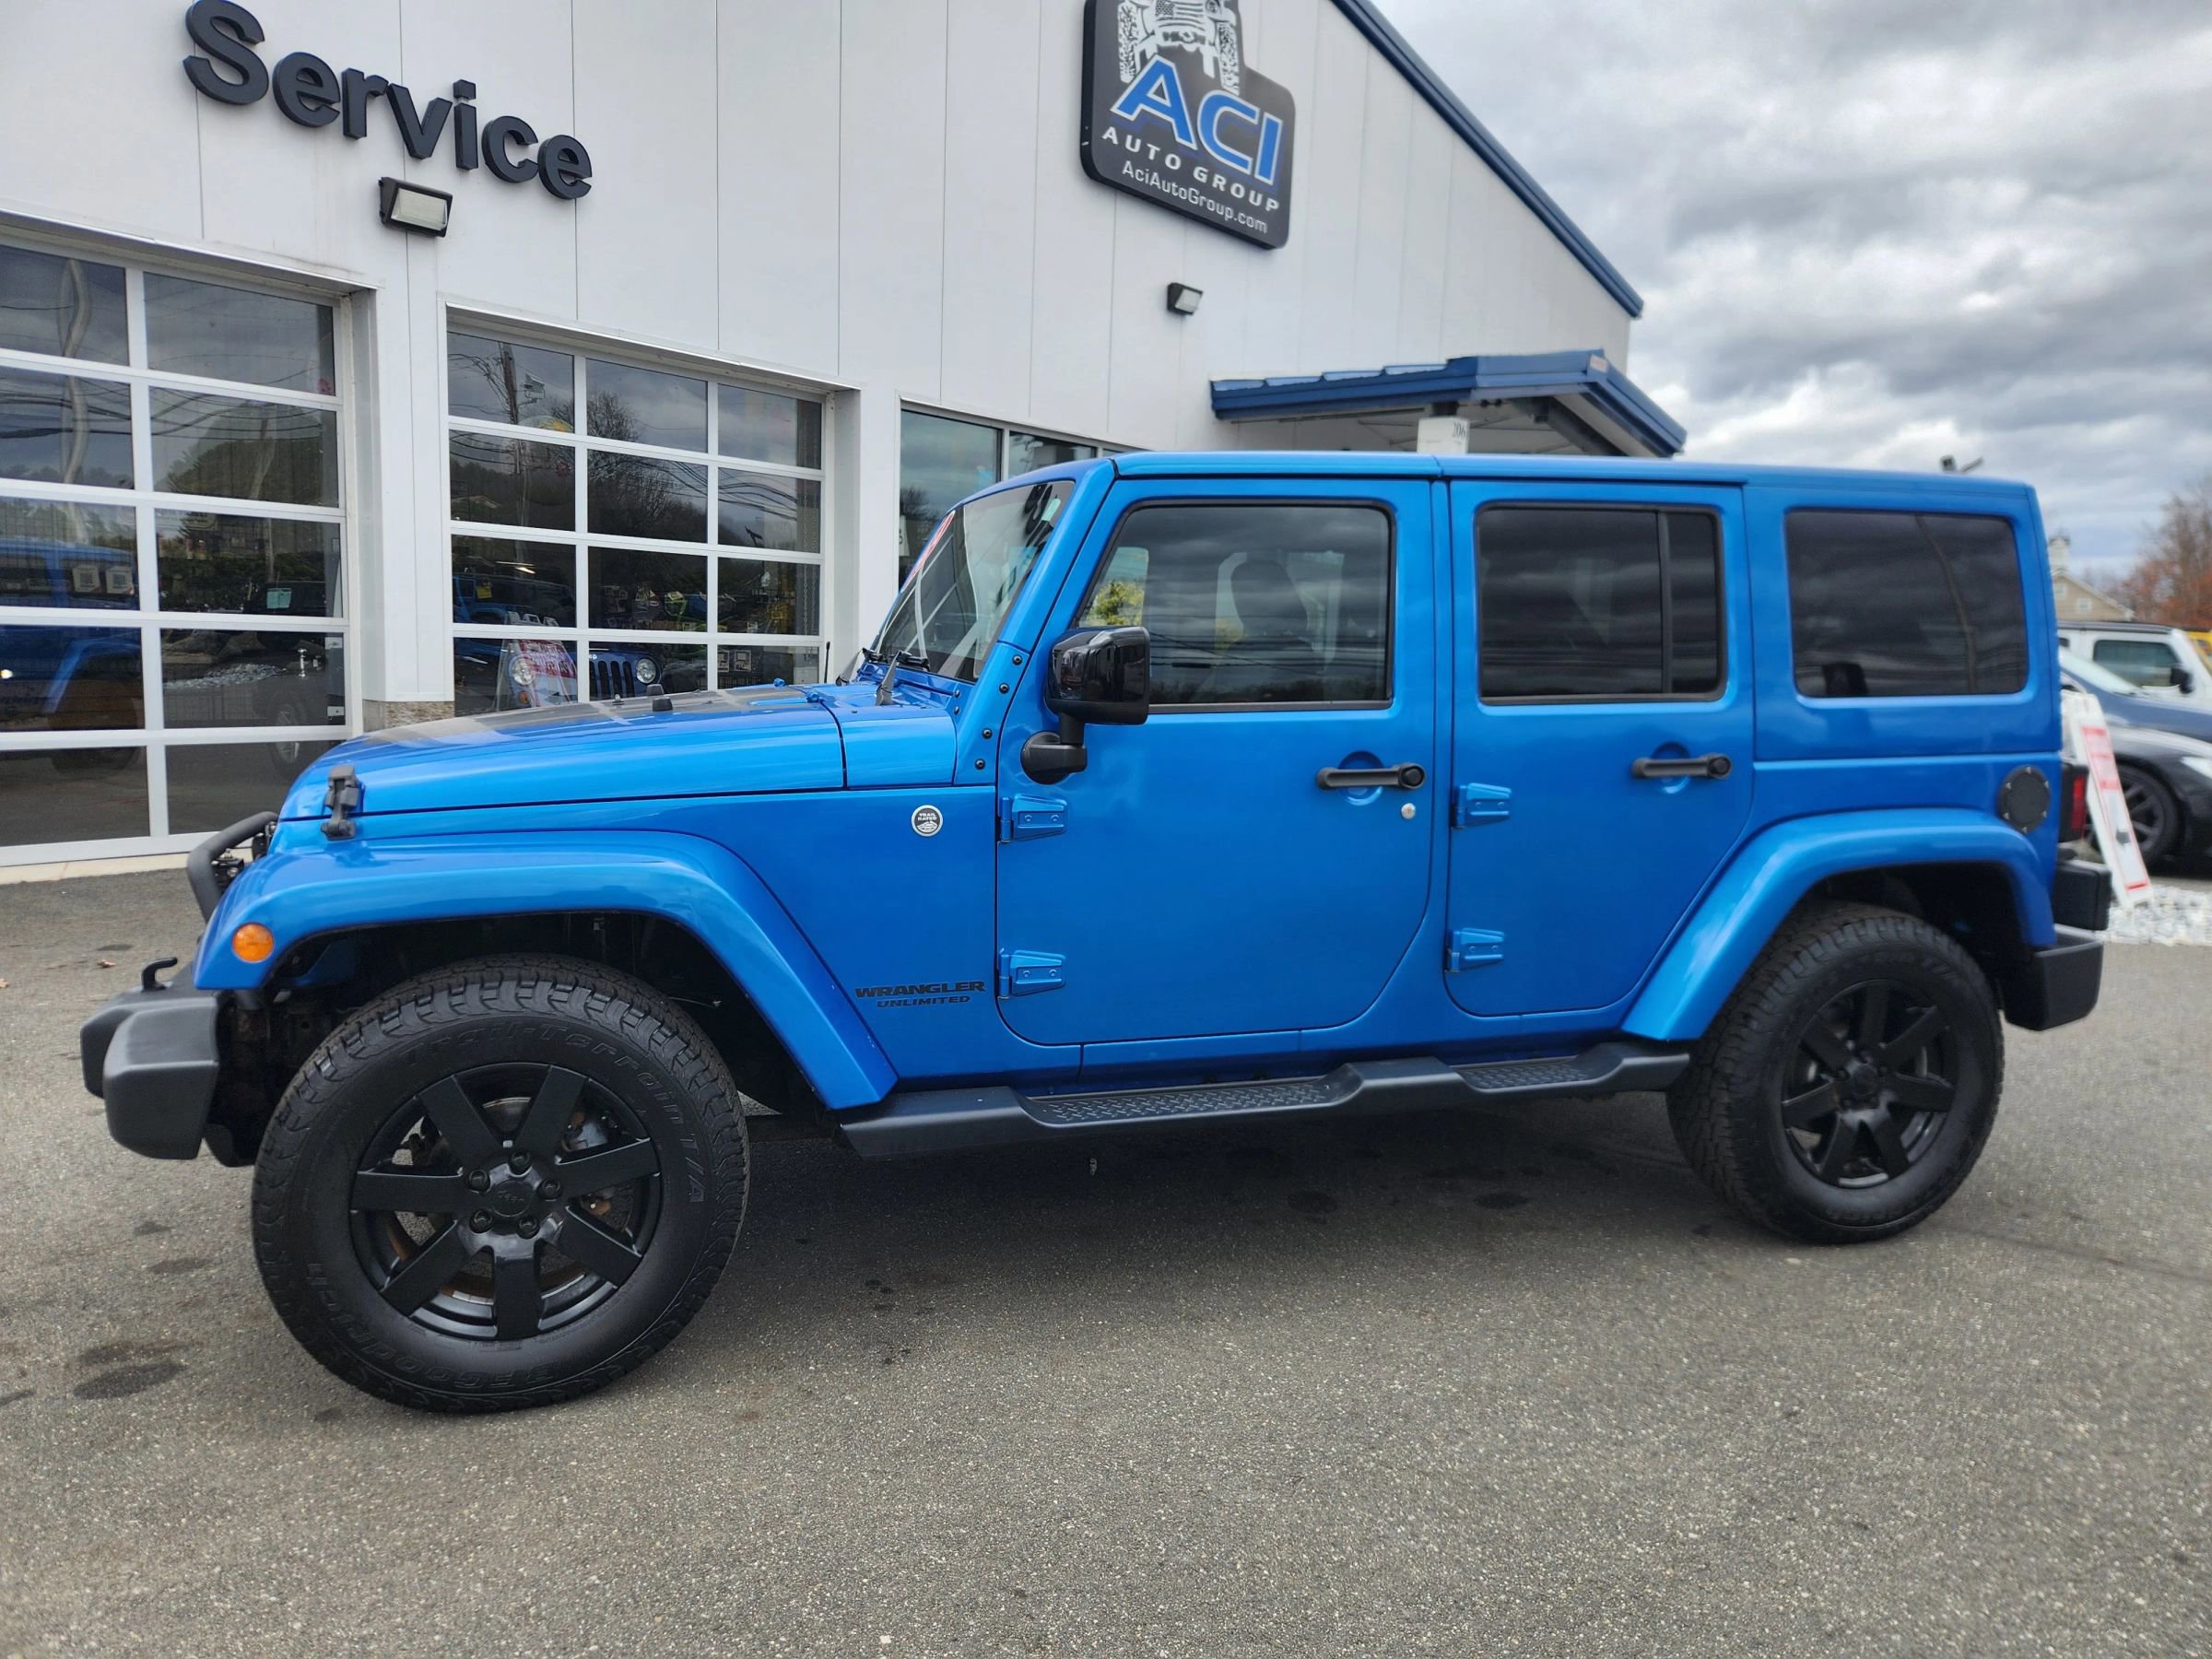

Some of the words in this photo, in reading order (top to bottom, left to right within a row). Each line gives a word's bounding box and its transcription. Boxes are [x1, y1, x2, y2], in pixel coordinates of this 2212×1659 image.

[183, 0, 593, 200] Service
[1110, 54, 1282, 185] ACI
[1101, 125, 1182, 171] AUTO
[1193, 166, 1279, 213] GROUP
[1122, 159, 1268, 234] AciAutoGroup.com
[856, 981, 985, 998] WRANGLER
[877, 995, 971, 1007] UNLIMITED
